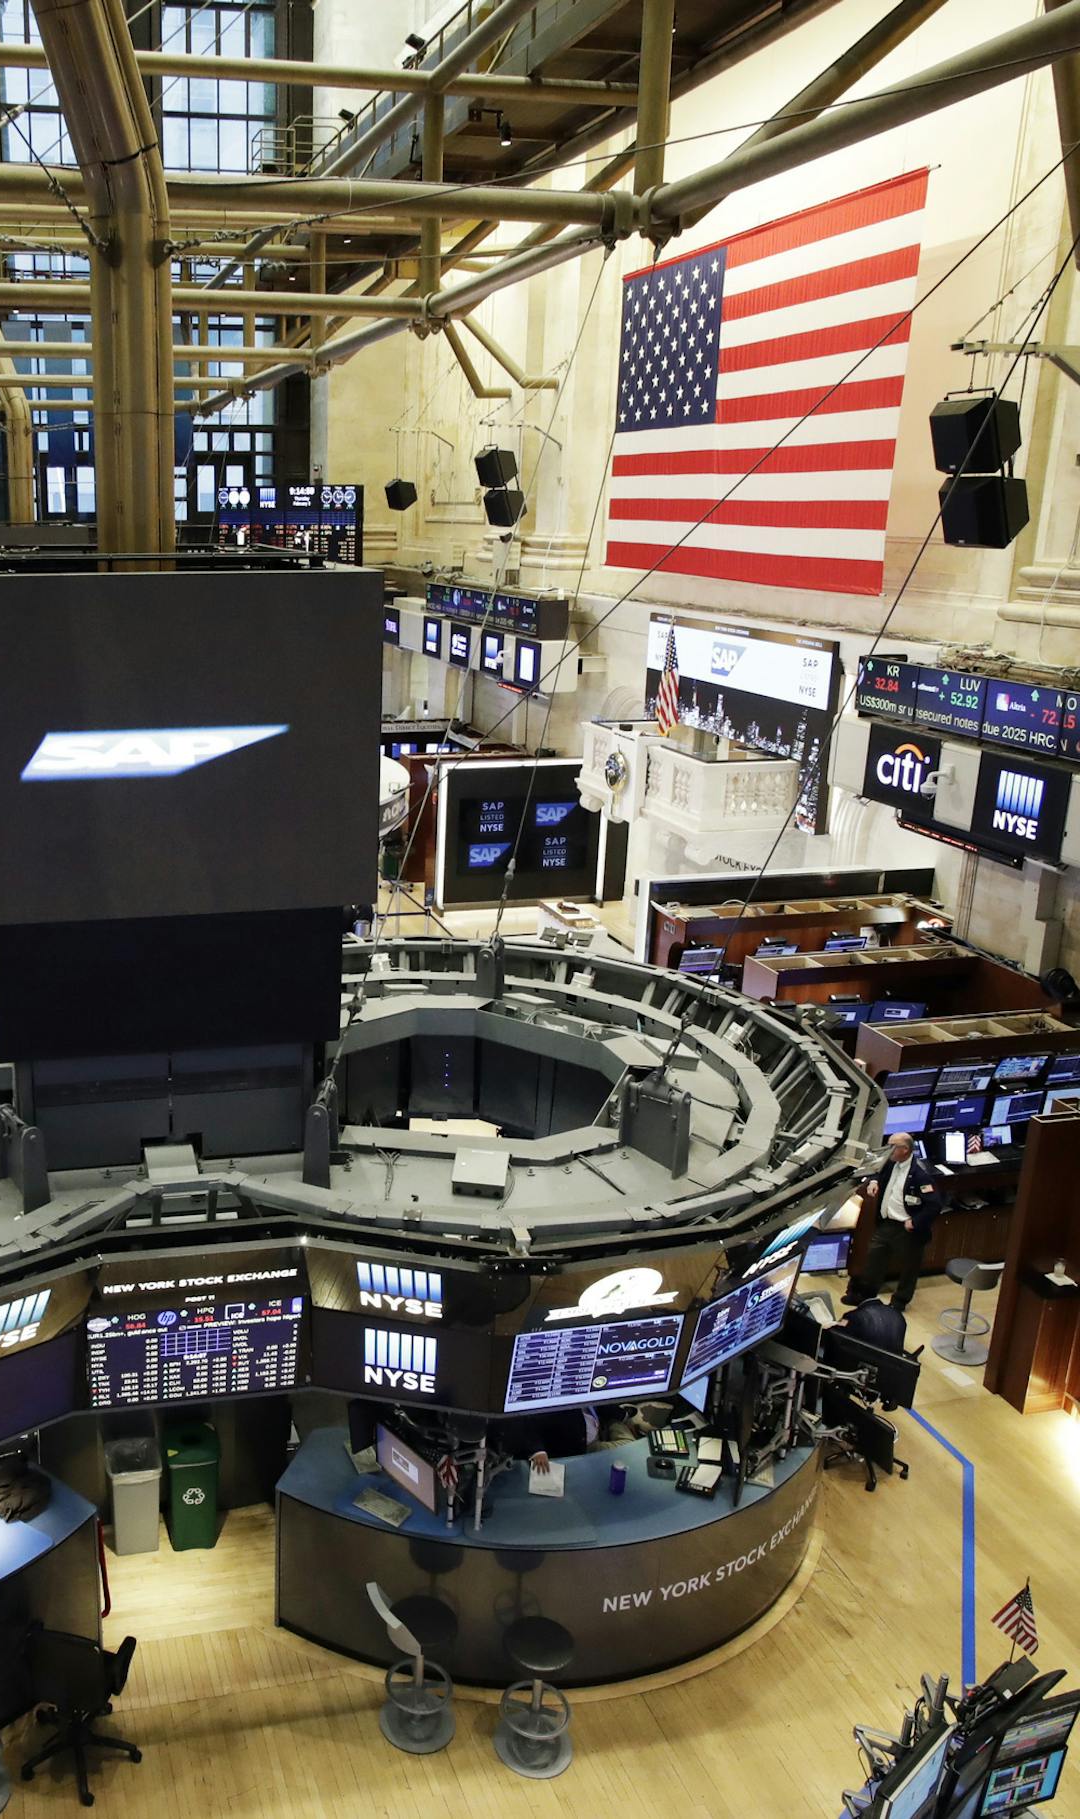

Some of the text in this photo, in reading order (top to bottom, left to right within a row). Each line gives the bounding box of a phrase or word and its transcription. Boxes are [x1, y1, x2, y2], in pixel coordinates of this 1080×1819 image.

[711, 646, 739, 671] SAP
[802, 657, 819, 668] SAP
[886, 664, 900, 678] KR
[959, 678, 981, 692] LUV
[799, 685, 817, 698] NYSE
[875, 677, 899, 693] 32.84
[950, 691, 979, 710] 52.92
[1009, 701, 1027, 713] Altria
[859, 694, 897, 713] US$300m
[898, 705, 907, 716] sr
[953, 718, 980, 731] notes
[982, 720, 1000, 737] due
[1001, 725, 1027, 742] 2025
[32, 735, 234, 770] SAP
[482, 801, 505, 811] SAP
[536, 806, 569, 823] SAP
[480, 813, 505, 821] LISTED
[992, 809, 1039, 841] NYSE
[479, 823, 505, 833] NYSE
[545, 836, 567, 846] SAP
[470, 847, 502, 863] SAP
[542, 857, 566, 867] NYSE
[543, 848, 567, 856] LISTED
[103, 1268, 299, 1295] NEW YORK STOCK EXCHANGE
[127, 1312, 147, 1321] HOG
[196, 1306, 215, 1315] HPQ
[230, 1312, 245, 1320] ICE
[268, 1299, 282, 1307] ICE
[360, 1290, 443, 1319] NYSE
[203, 1320, 237, 1328] PREVIEW:
[598, 1335, 676, 1355] NOVAGOLD
[364, 1365, 436, 1393] NYSE
[602, 1589, 652, 1613] NEW
[659, 1571, 712, 1601] YORK
[715, 1542, 767, 1582] STOCK
